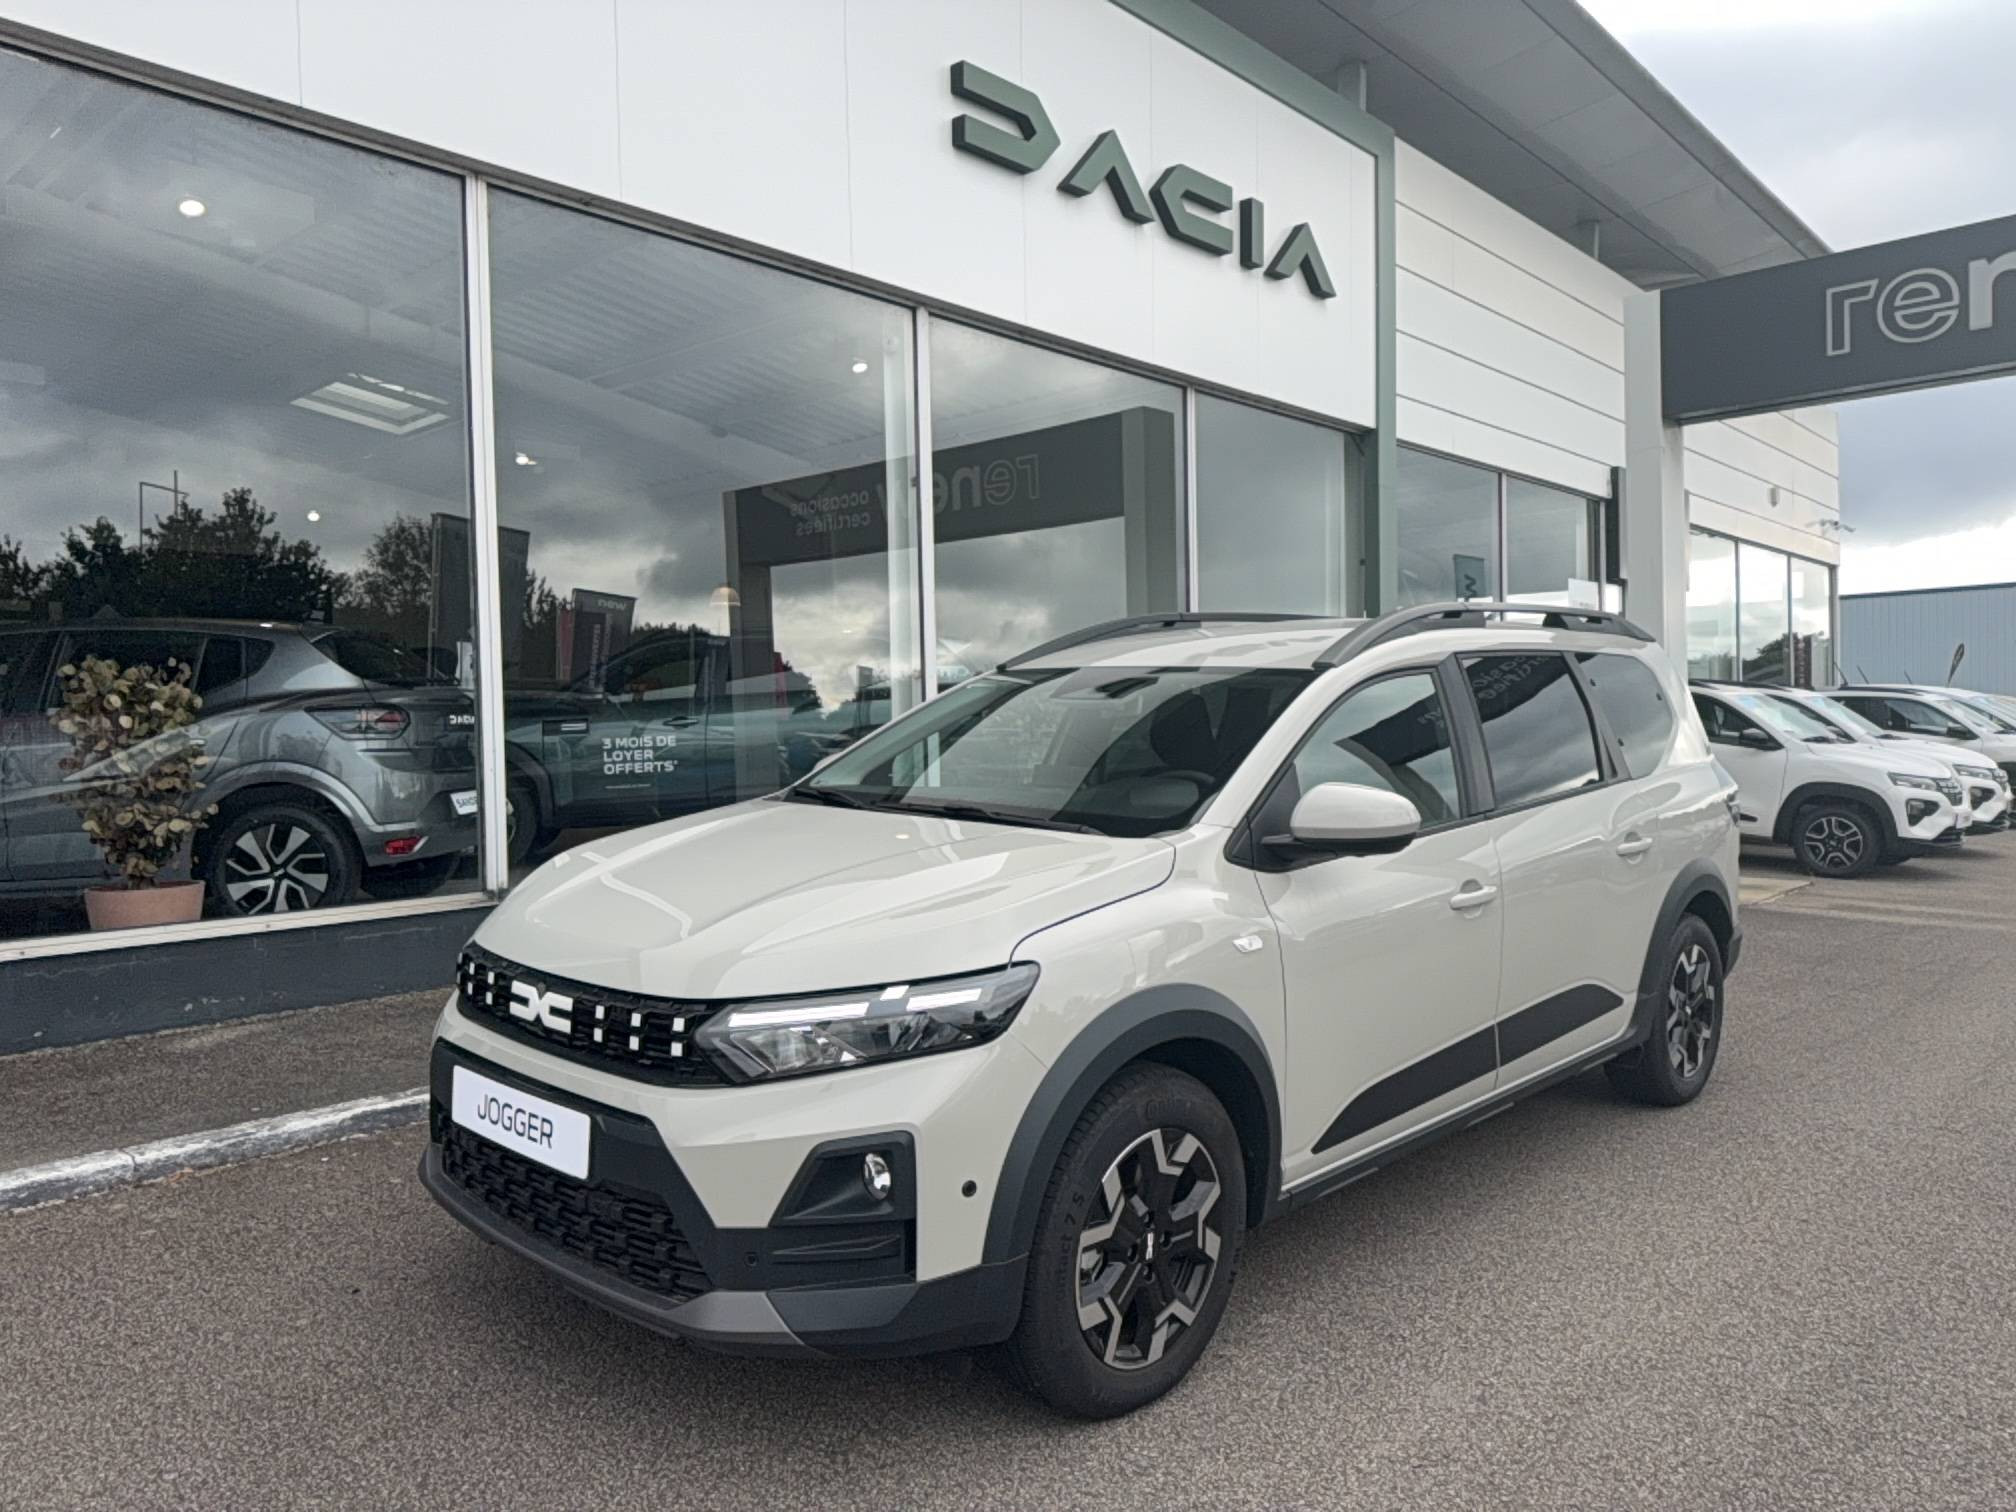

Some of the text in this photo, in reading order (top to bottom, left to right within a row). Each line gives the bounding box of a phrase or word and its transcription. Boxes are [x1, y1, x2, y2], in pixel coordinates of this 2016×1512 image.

[950, 60, 1337, 299] DACIA
[602, 735, 677, 749] 3 MOIS DE
[603, 749, 654, 763] LOYER
[477, 1094, 554, 1149] JOGGER
